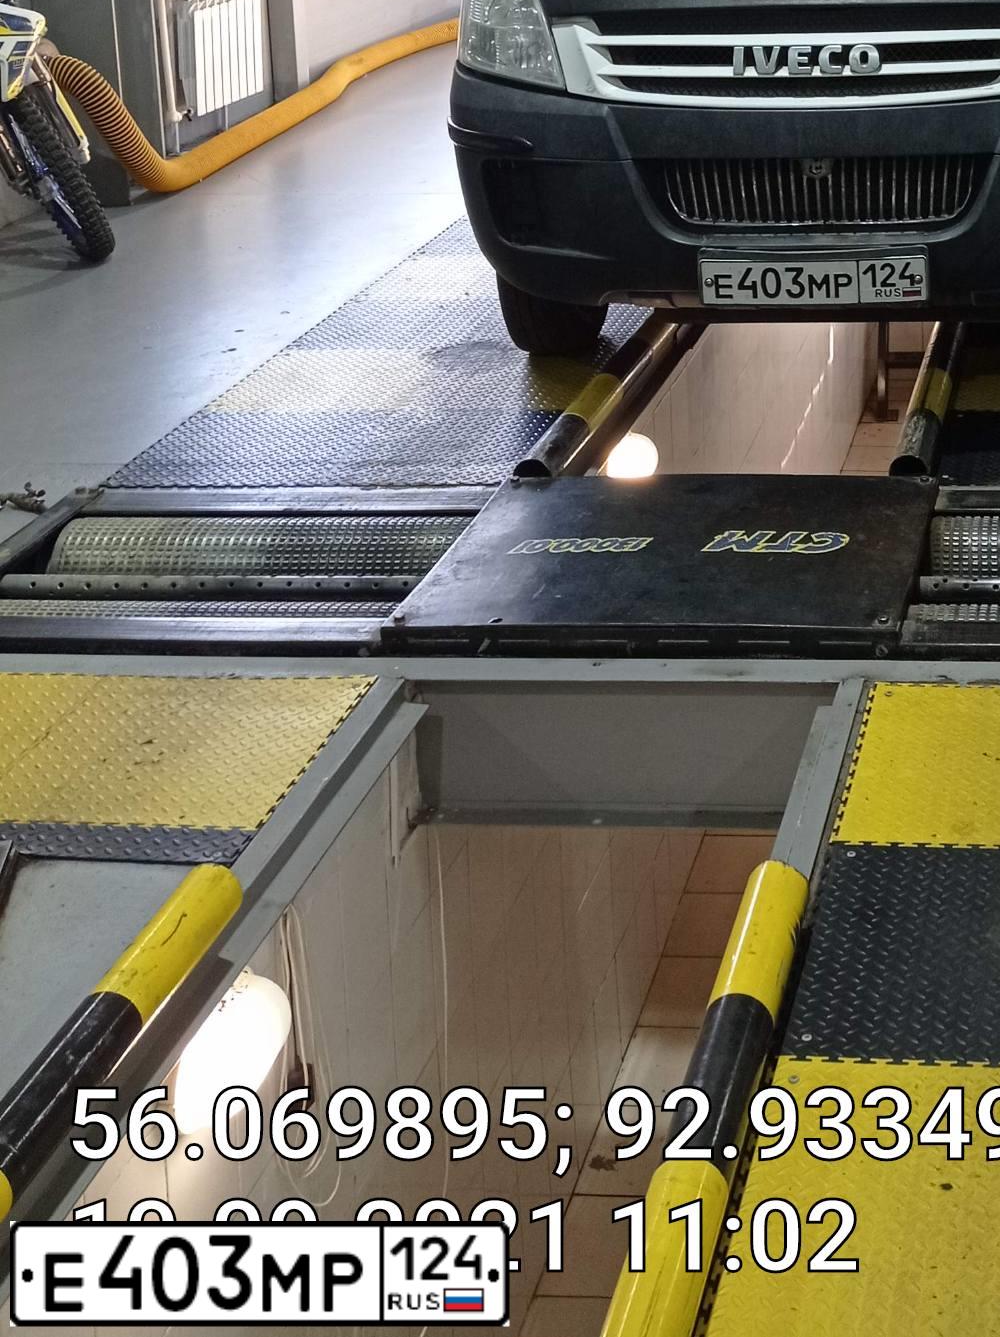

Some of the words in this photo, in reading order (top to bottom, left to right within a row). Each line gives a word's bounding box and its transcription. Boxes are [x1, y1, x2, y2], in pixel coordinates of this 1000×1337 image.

[732, 44, 882, 76] IVECO
[713, 266, 853, 299] Е403МР
[862, 261, 916, 289] 124
[874, 288, 902, 299] RUS
